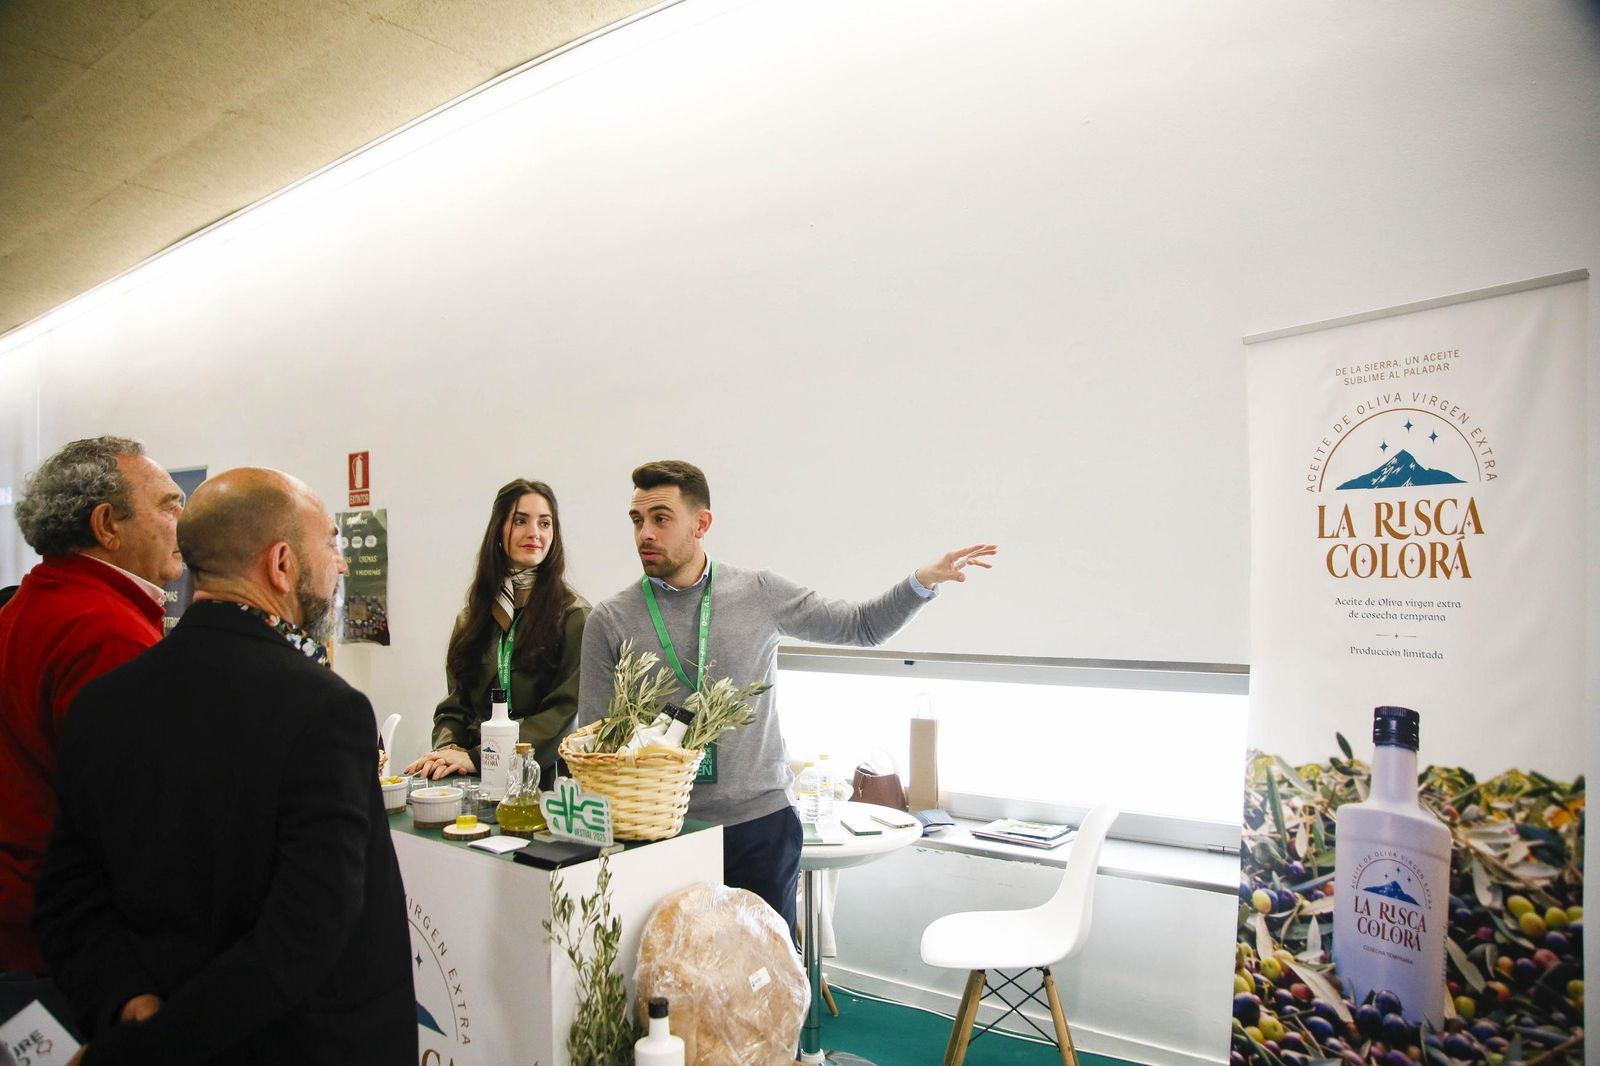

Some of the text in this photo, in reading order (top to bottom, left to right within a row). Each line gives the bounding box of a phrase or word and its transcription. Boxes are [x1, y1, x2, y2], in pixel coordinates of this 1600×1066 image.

[1335, 349, 1461, 377] DE LA SIERRA, UN ACEITE
[1343, 362, 1450, 386] SUBLIME AL PALADAR
[1306, 391, 1498, 493] ACEITE DE OLIVA VIRGEN EXTRA
[1316, 496, 1486, 541] LA RISCA
[1325, 535, 1473, 581] COLORÁ
[1335, 597, 1462, 609] Aceite de Oliva virgen extra
[1348, 610, 1446, 622] de cosecha temprana
[1350, 646, 1444, 660] Producción limitada
[1354, 895, 1426, 933] LA RISCA
[405, 894, 472, 1046] IRGEN EXTRA
